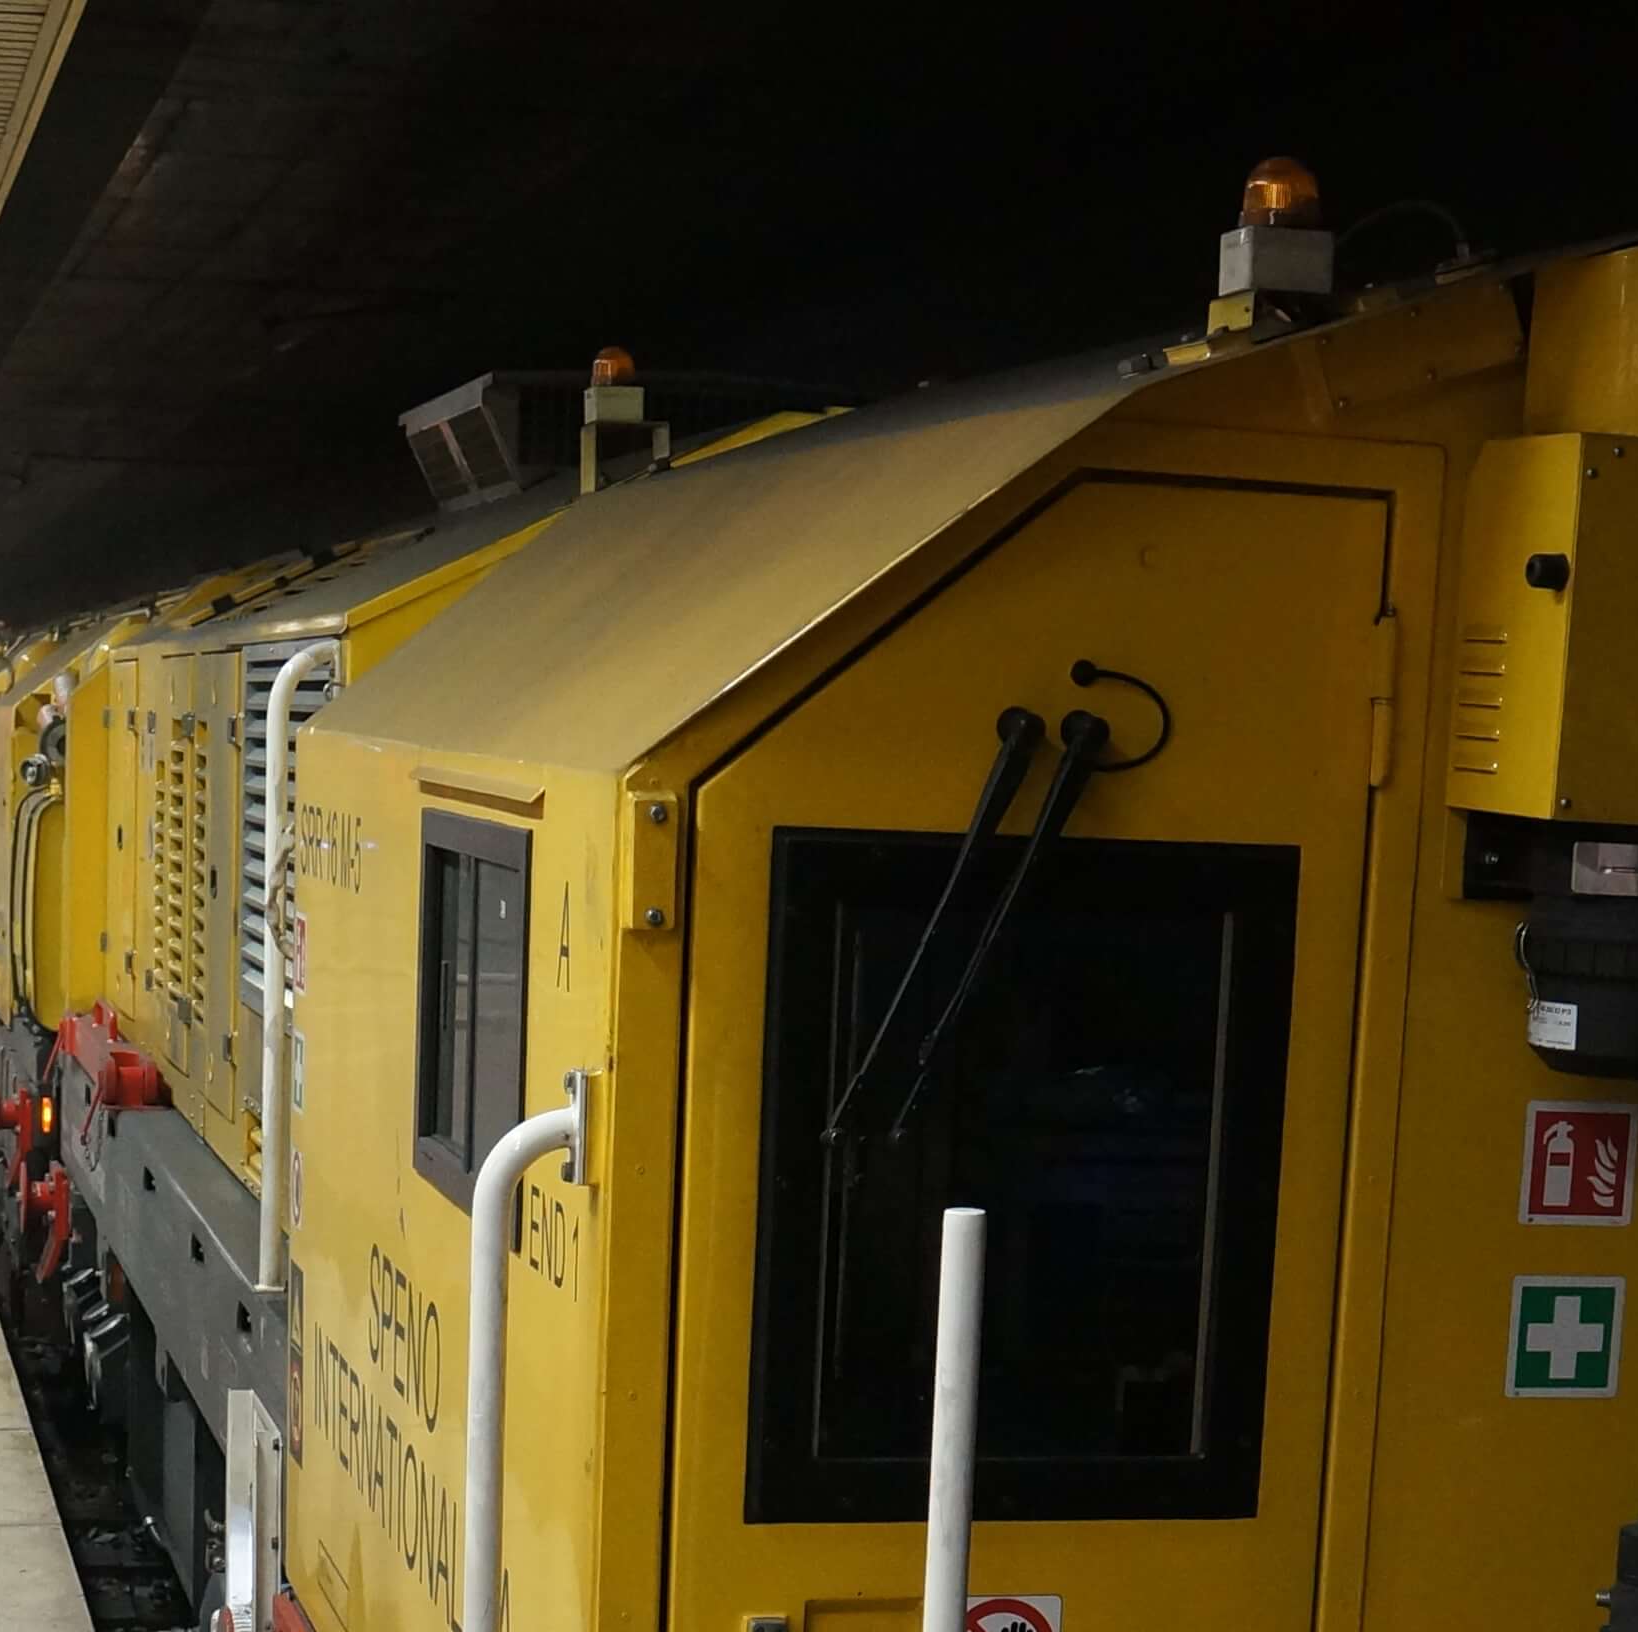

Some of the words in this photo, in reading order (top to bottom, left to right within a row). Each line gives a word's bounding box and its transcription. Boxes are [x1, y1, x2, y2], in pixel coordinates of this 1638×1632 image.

[300, 804, 323, 880] SRR
[326, 810, 339, 887] 16
[340, 812, 362, 894] M-5
[556, 880, 571, 993] A
[529, 1183, 566, 1289] END
[571, 1215, 580, 1303] 1
[368, 1243, 441, 1433] SPENO
